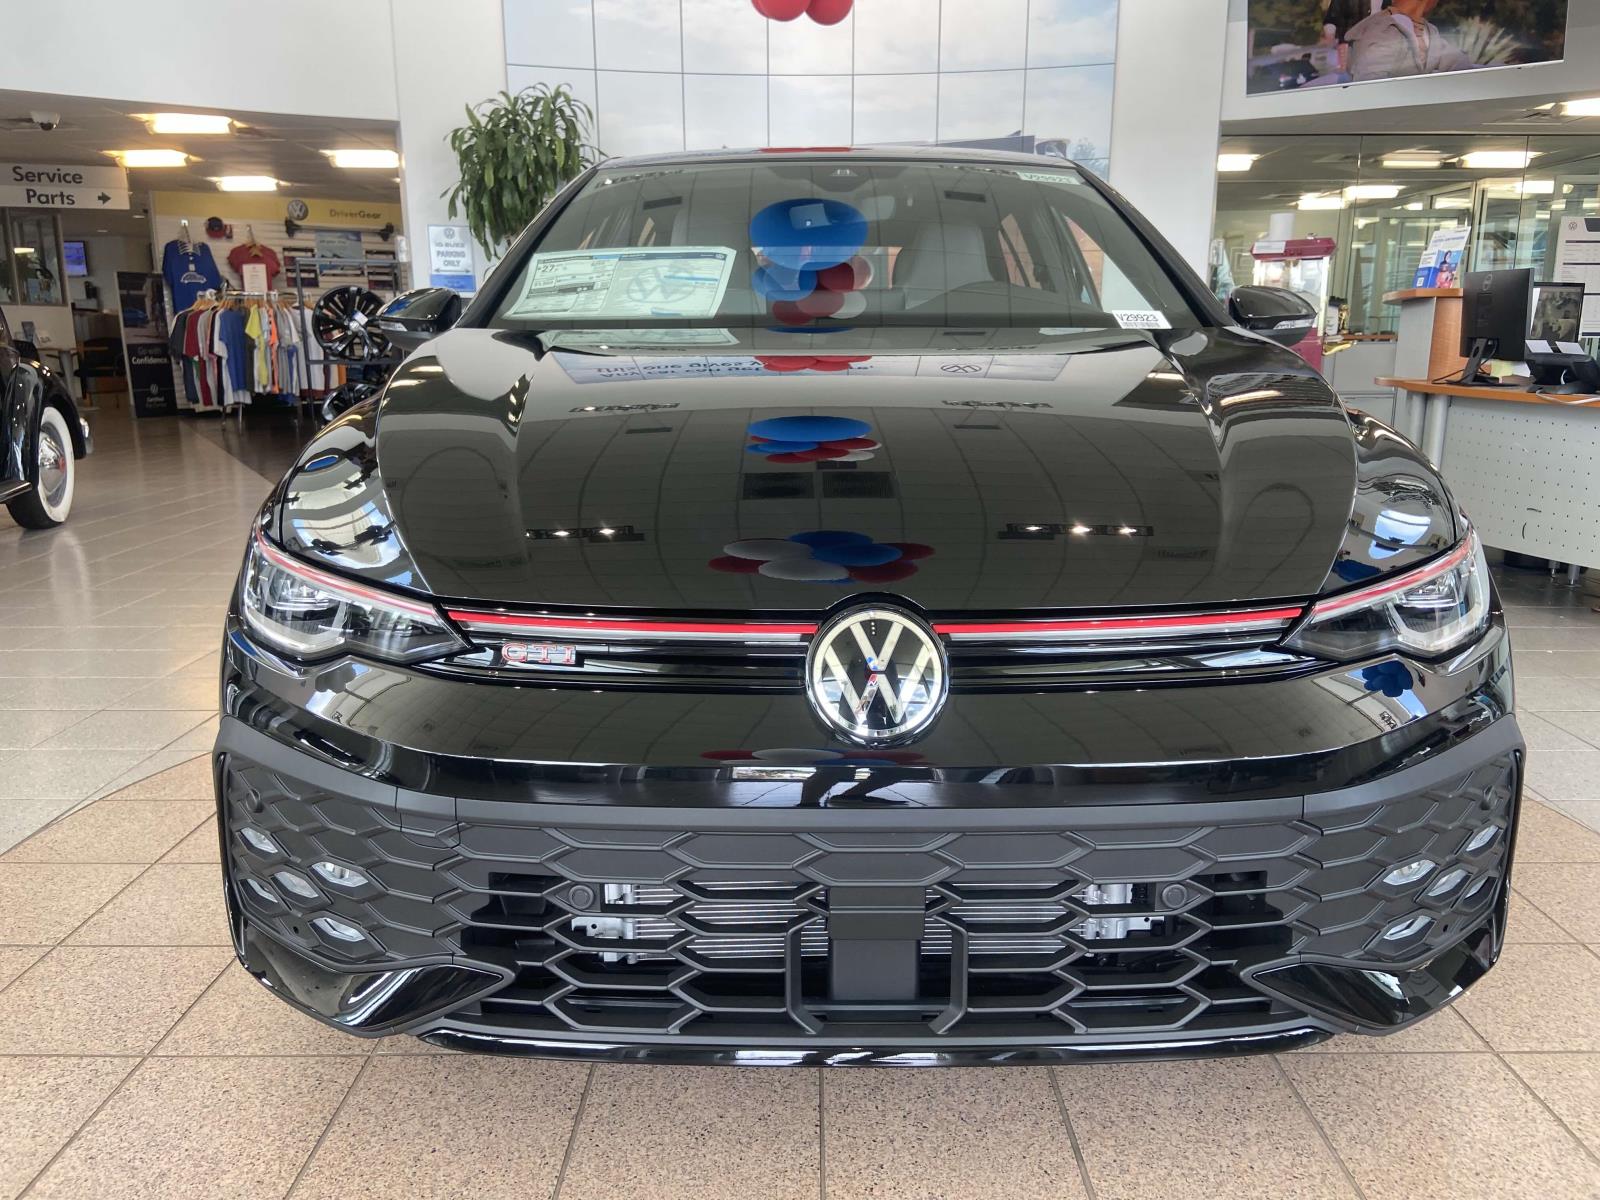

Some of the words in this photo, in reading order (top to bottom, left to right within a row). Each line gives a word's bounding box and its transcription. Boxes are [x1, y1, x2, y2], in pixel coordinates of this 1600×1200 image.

[12, 165, 83, 184] Service
[25, 188, 76, 205] Parts
[329, 208, 382, 219] DriverGear
[436, 250, 466, 258] PARKING
[443, 259, 461, 267] ONLY
[501, 641, 576, 664] GTI
